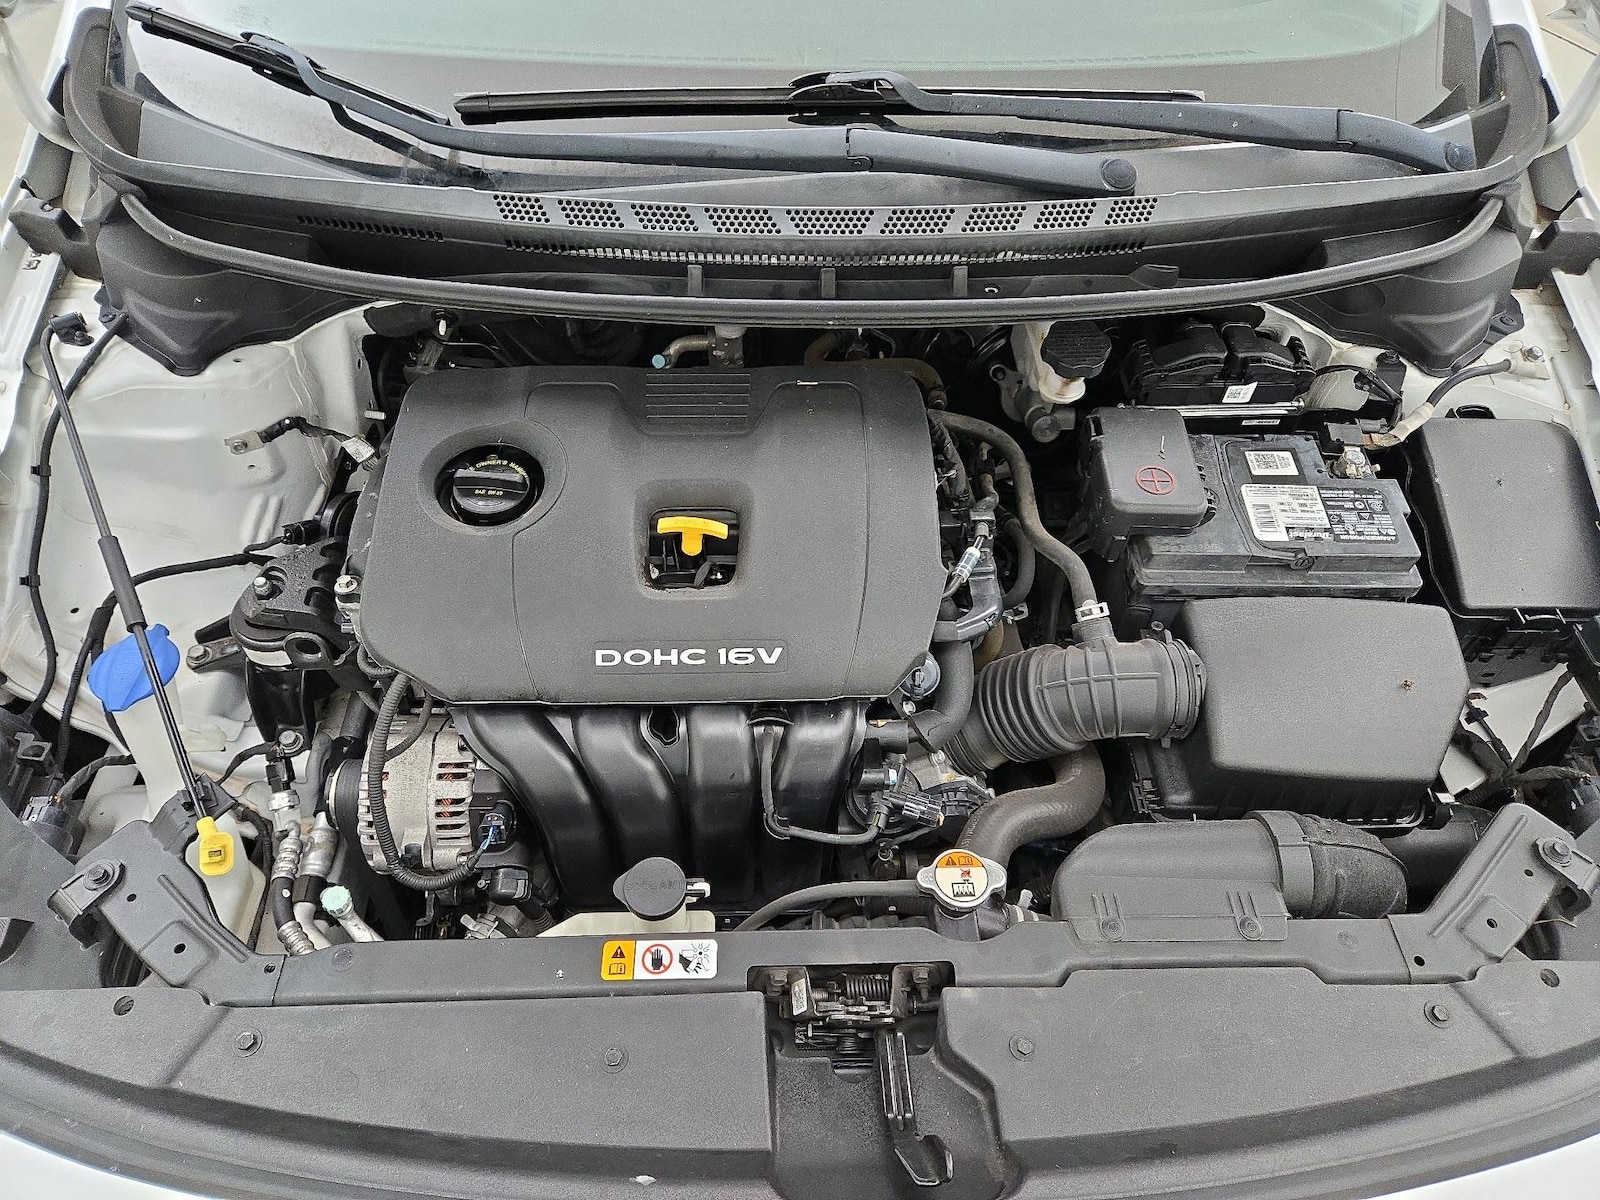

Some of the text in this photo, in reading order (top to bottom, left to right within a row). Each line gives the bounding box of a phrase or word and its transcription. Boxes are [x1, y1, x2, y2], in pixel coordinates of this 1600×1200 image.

[475, 460, 508, 468] OWNER'S
[1288, 529, 1329, 539] Duralast
[595, 647, 784, 666] DOHC 16V
